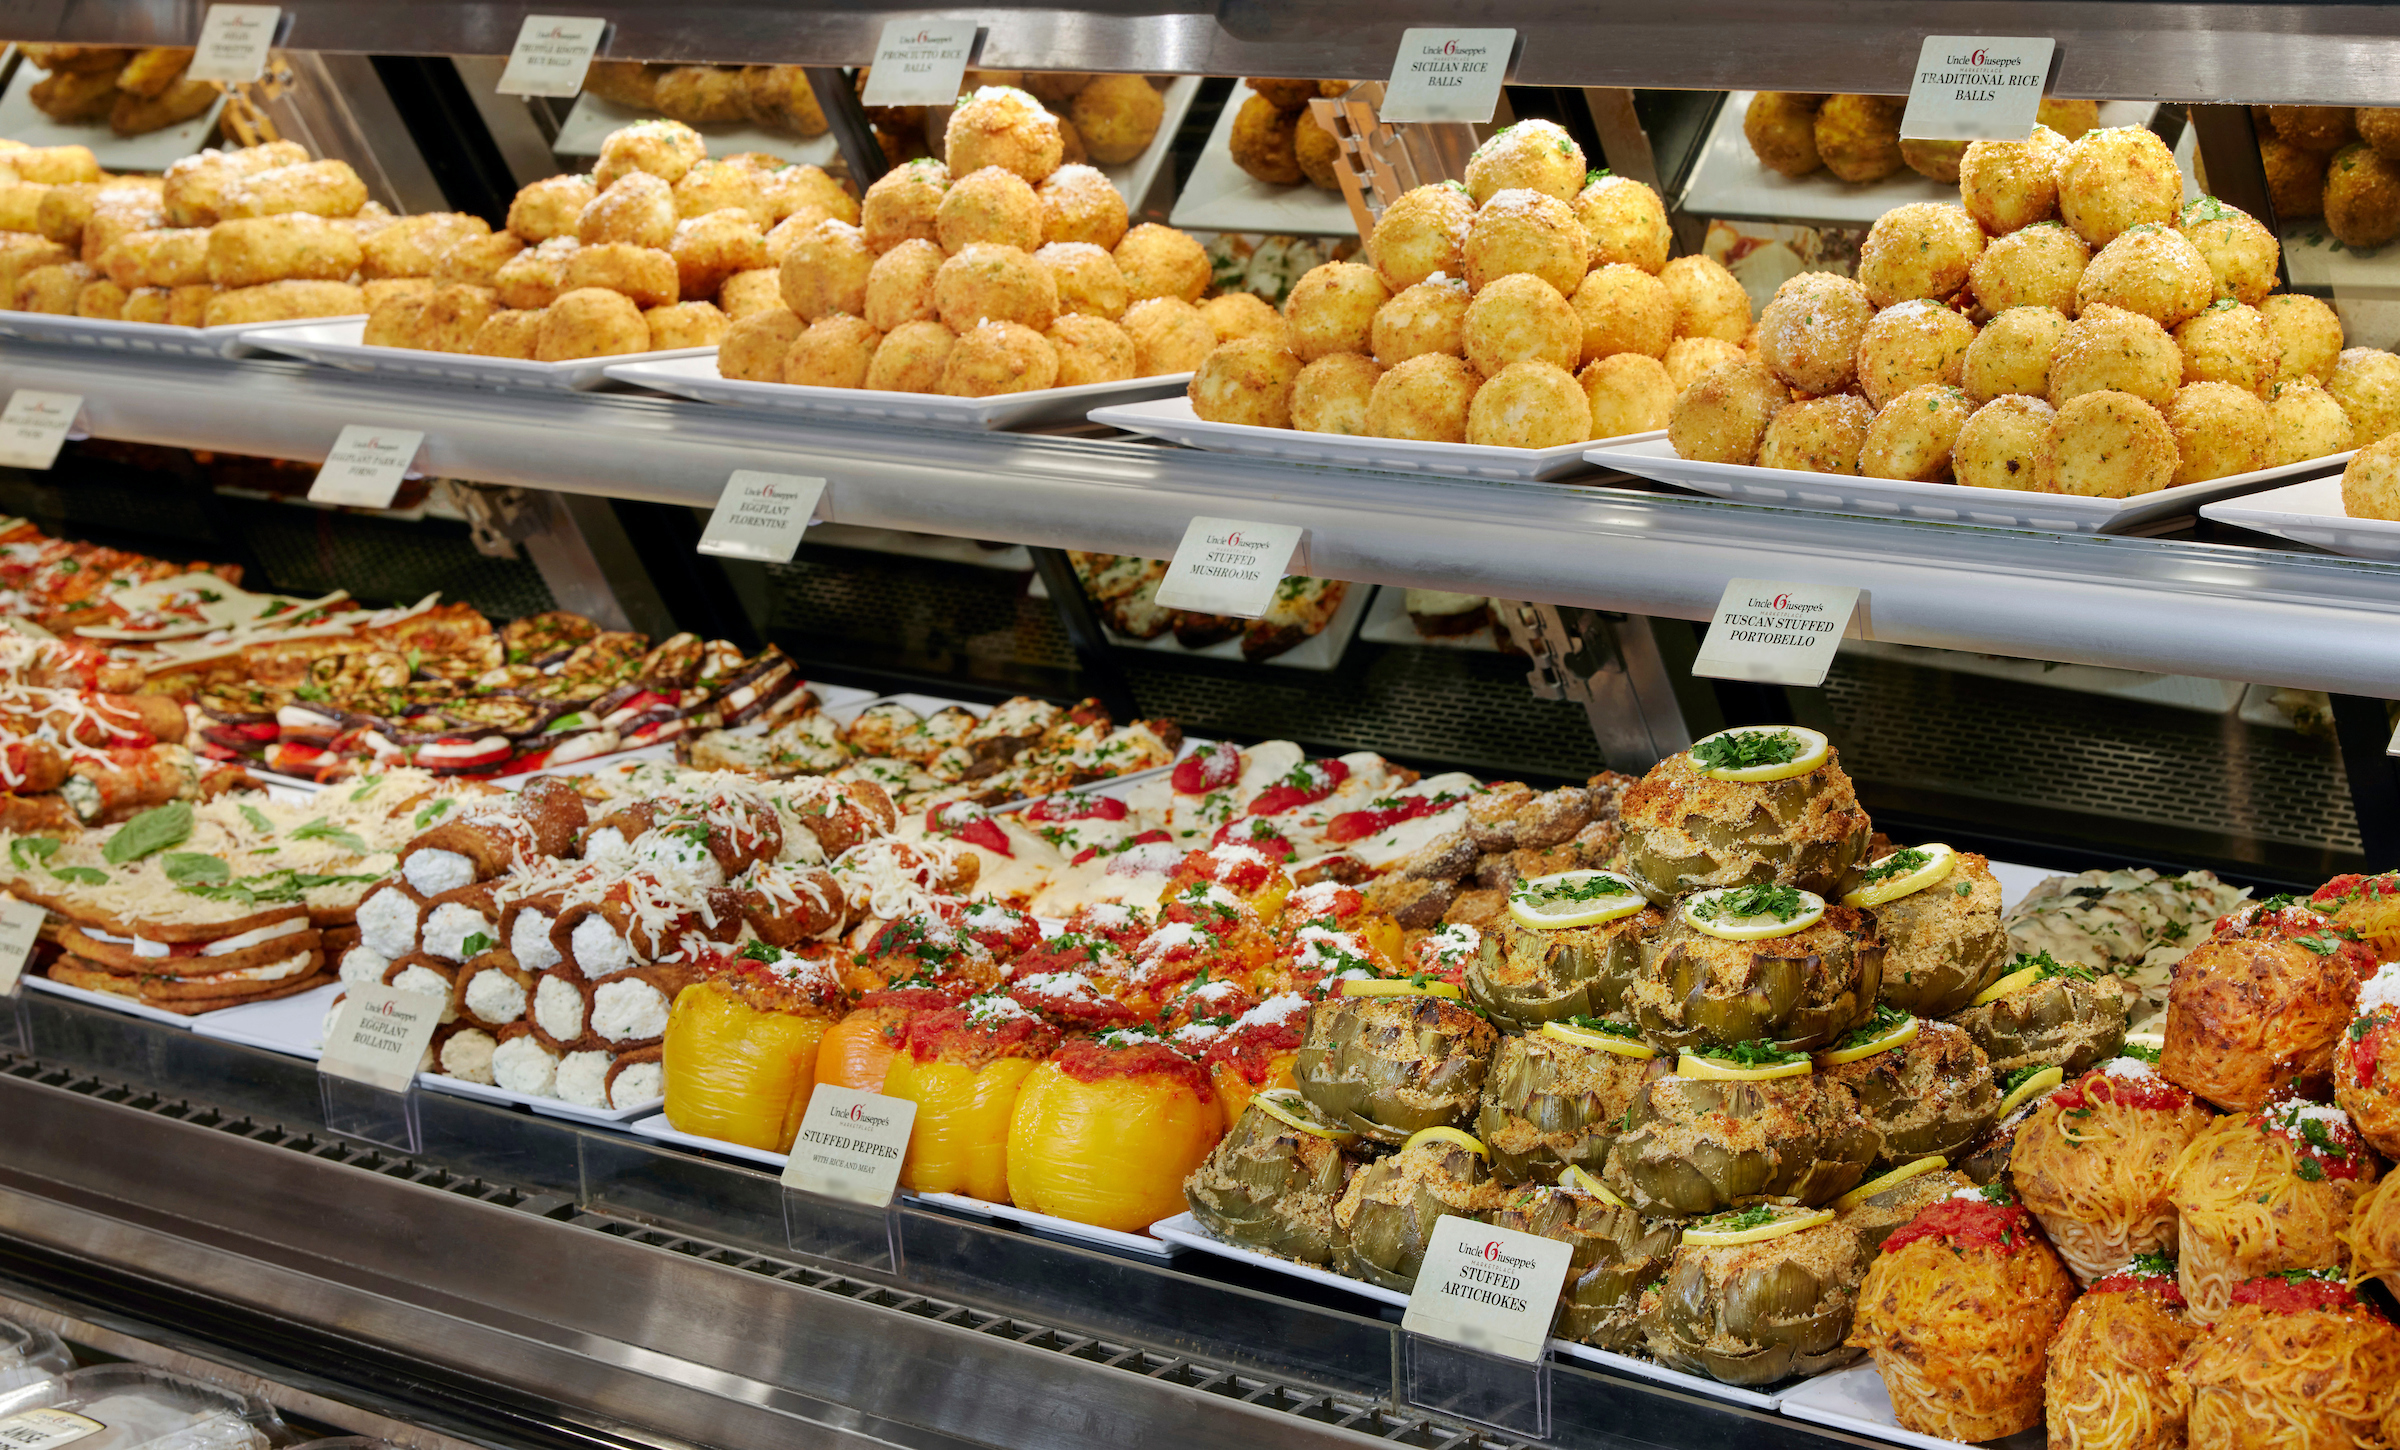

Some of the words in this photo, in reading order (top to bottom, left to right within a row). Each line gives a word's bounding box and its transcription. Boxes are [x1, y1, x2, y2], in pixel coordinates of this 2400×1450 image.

[882, 50, 939, 60] PROSCIUTTO
[940, 50, 962, 60] RICE
[1422, 46, 1443, 54] Uncle
[1444, 39, 1486, 56] Giuseppe's
[1946, 55, 1970, 65] Uncle
[1972, 48, 2022, 68] Giuseppe's
[903, 62, 933, 72] BALLS
[1411, 62, 1460, 72] SICILIAN
[1461, 62, 1488, 72] RICE
[1428, 76, 1463, 86] BALLS
[1920, 73, 2005, 86] TRADITIONAL
[2008, 75, 2040, 86] RICE
[1955, 90, 1996, 102] BALLS
[740, 502, 790, 516] EGGPLANT
[729, 514, 790, 529] FLORENTINE
[1206, 535, 1227, 545] Uncle
[1228, 531, 1270, 550] Giuseppe's
[1206, 552, 1256, 566] STUFFED
[1190, 564, 1260, 581] MUSHROOMS
[1748, 598, 1772, 608] Uncle
[1773, 592, 1824, 613] Giuseppe's
[1724, 614, 1775, 628] TUSCAN
[1776, 618, 1834, 632] STUFFED
[1730, 630, 1815, 647] PORTOBELLO
[364, 1002, 382, 1014] Uncle
[360, 1018, 408, 1038] EGGPLANT
[353, 1032, 402, 1054] ROLLATINI
[830, 1106, 850, 1119] Uncle
[850, 1104, 890, 1127] Giuseppe's
[840, 1122, 874, 1132] MARKETPLACE
[802, 1130, 850, 1150] STUFFED
[852, 1140, 898, 1160] PEPPERS
[813, 1154, 828, 1164] WITH
[829, 1157, 844, 1168] RICE
[844, 1160, 858, 1170] AND
[858, 1164, 876, 1174] MEAT
[1458, 1242, 1483, 1258] Uncle
[1484, 1241, 1536, 1270] Giuseppe's
[1471, 1260, 1516, 1274] MARKETPLACE
[1460, 1266, 1520, 1291] STUFFED
[1440, 1280, 1528, 1312] ARTICHOKES
